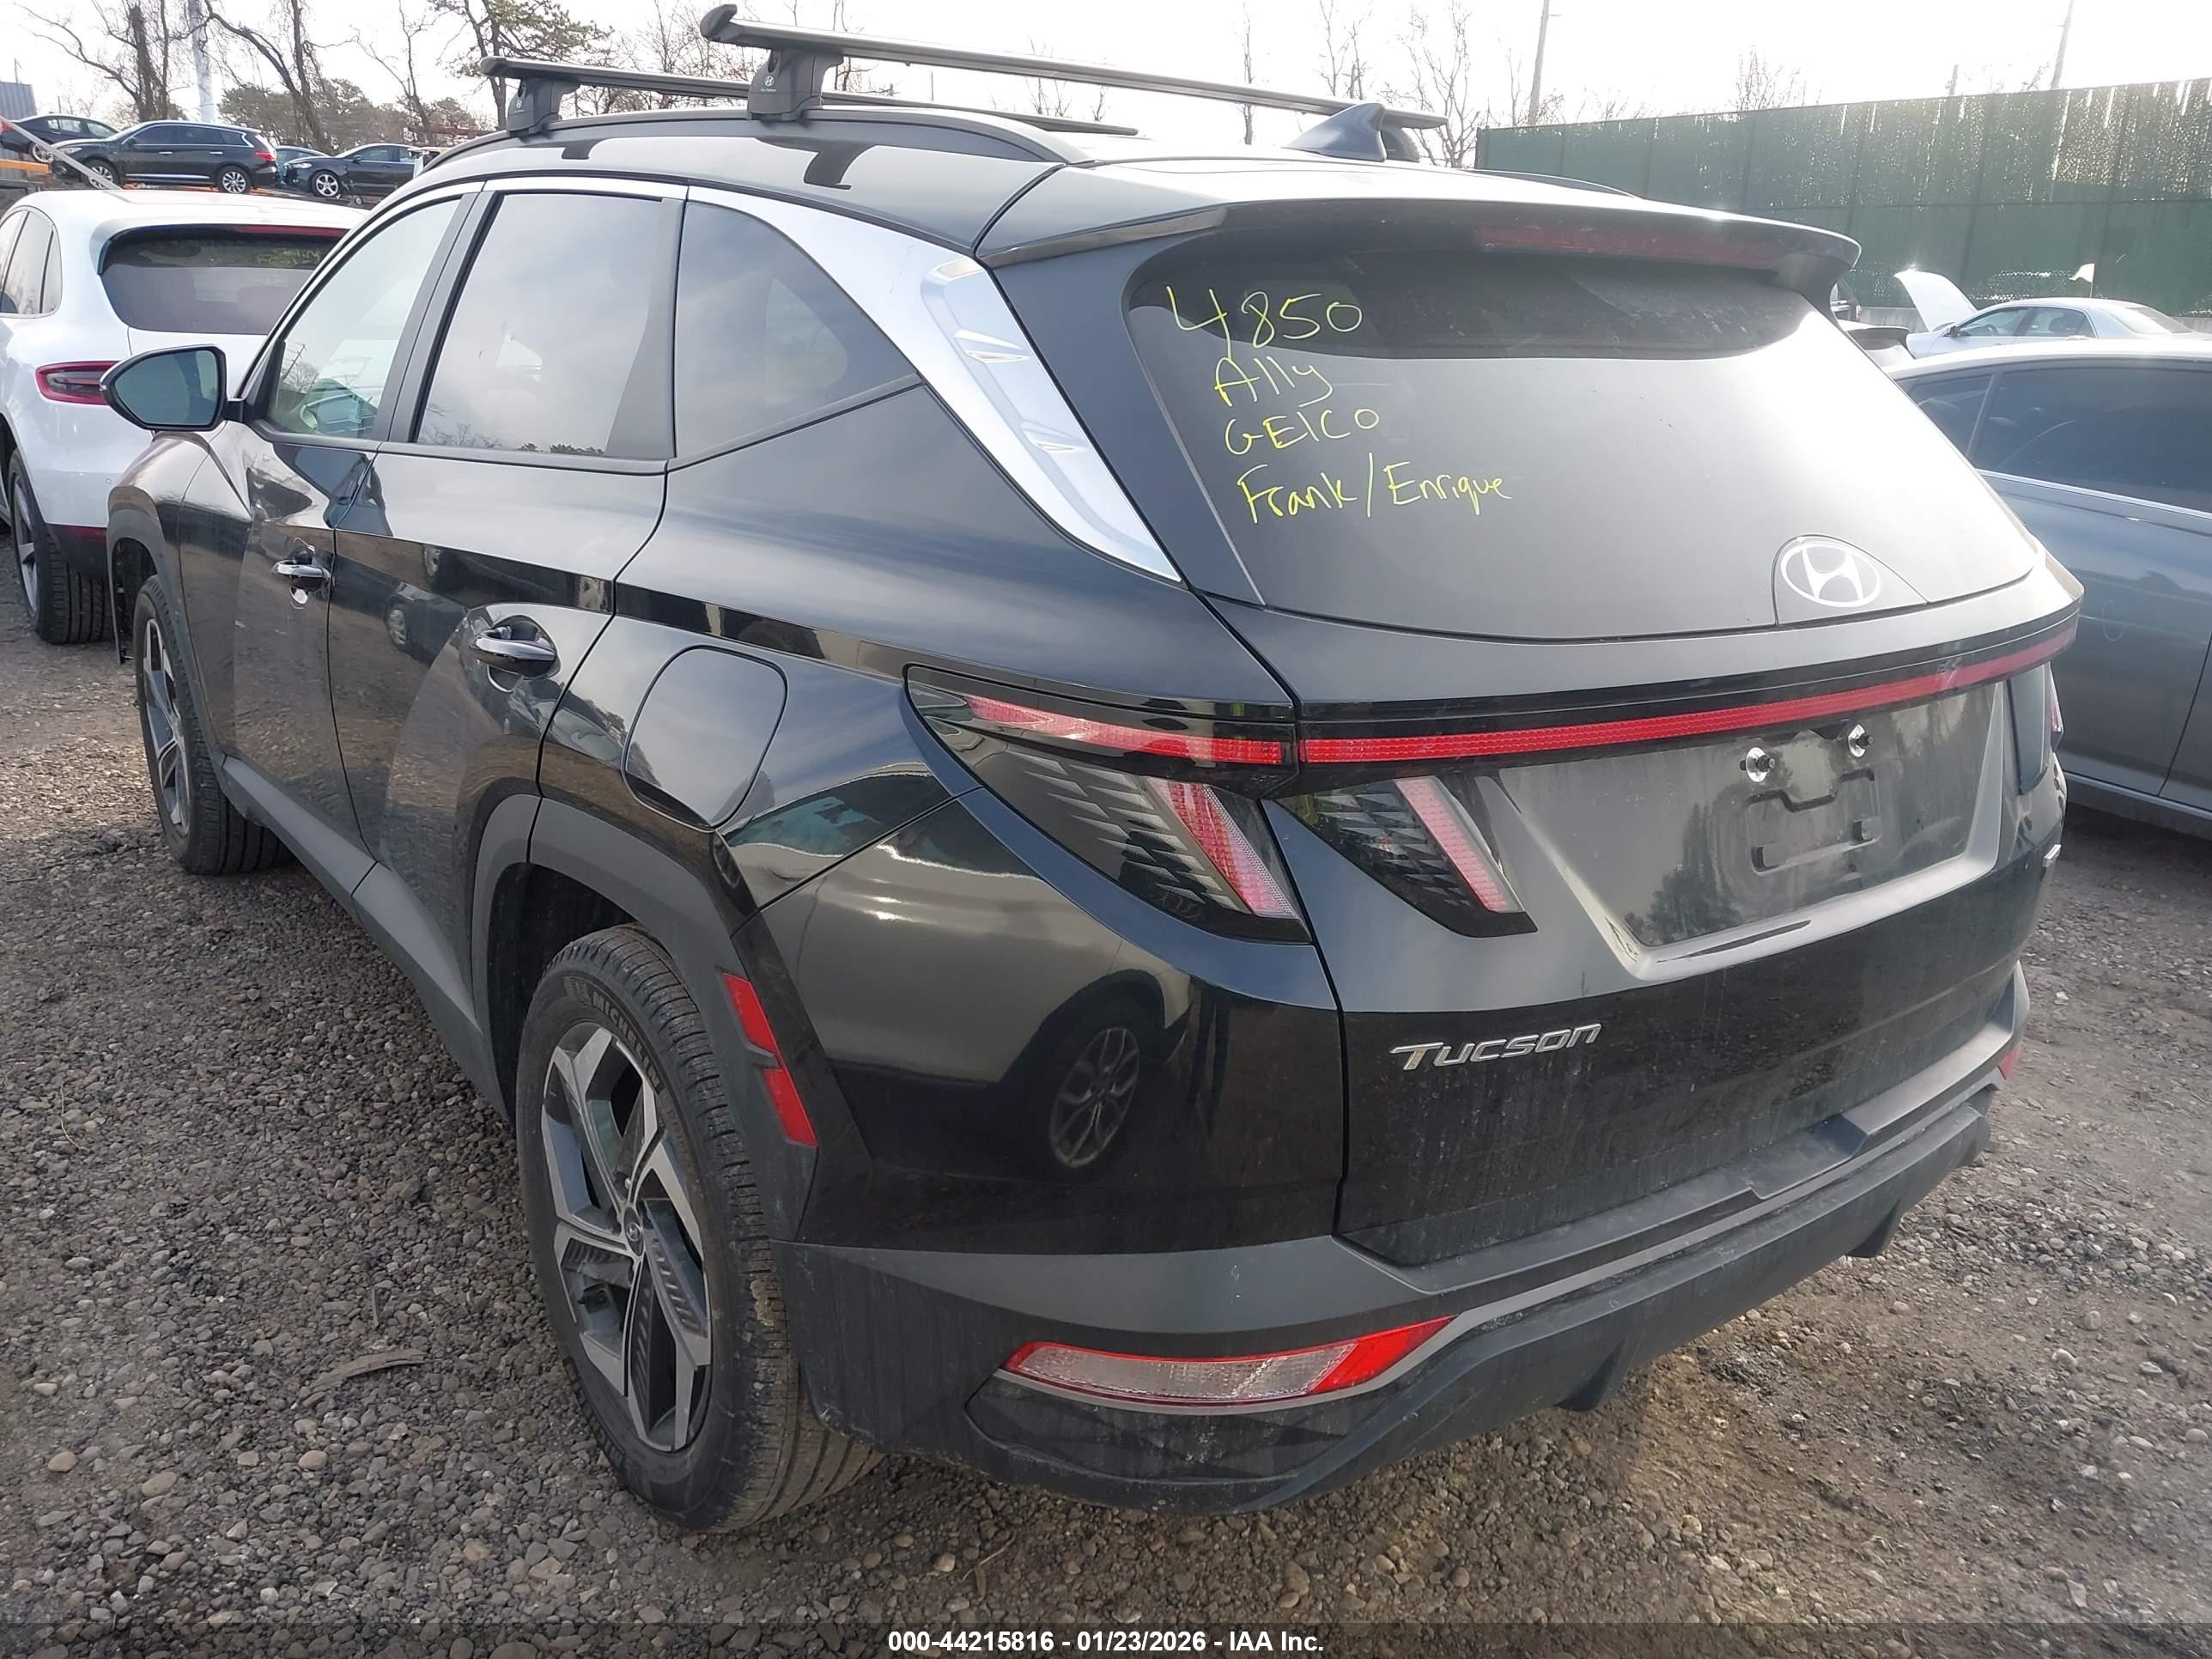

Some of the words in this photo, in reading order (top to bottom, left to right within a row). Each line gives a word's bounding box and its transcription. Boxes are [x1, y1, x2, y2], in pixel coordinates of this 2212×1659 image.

[1166, 285, 1363, 360] 4850
[1214, 356, 1334, 407] Ally
[1224, 408, 1380, 455] GEICO
[592, 990, 662, 1088] MICHELIN
[1389, 1023, 1602, 1071] TUCSON
